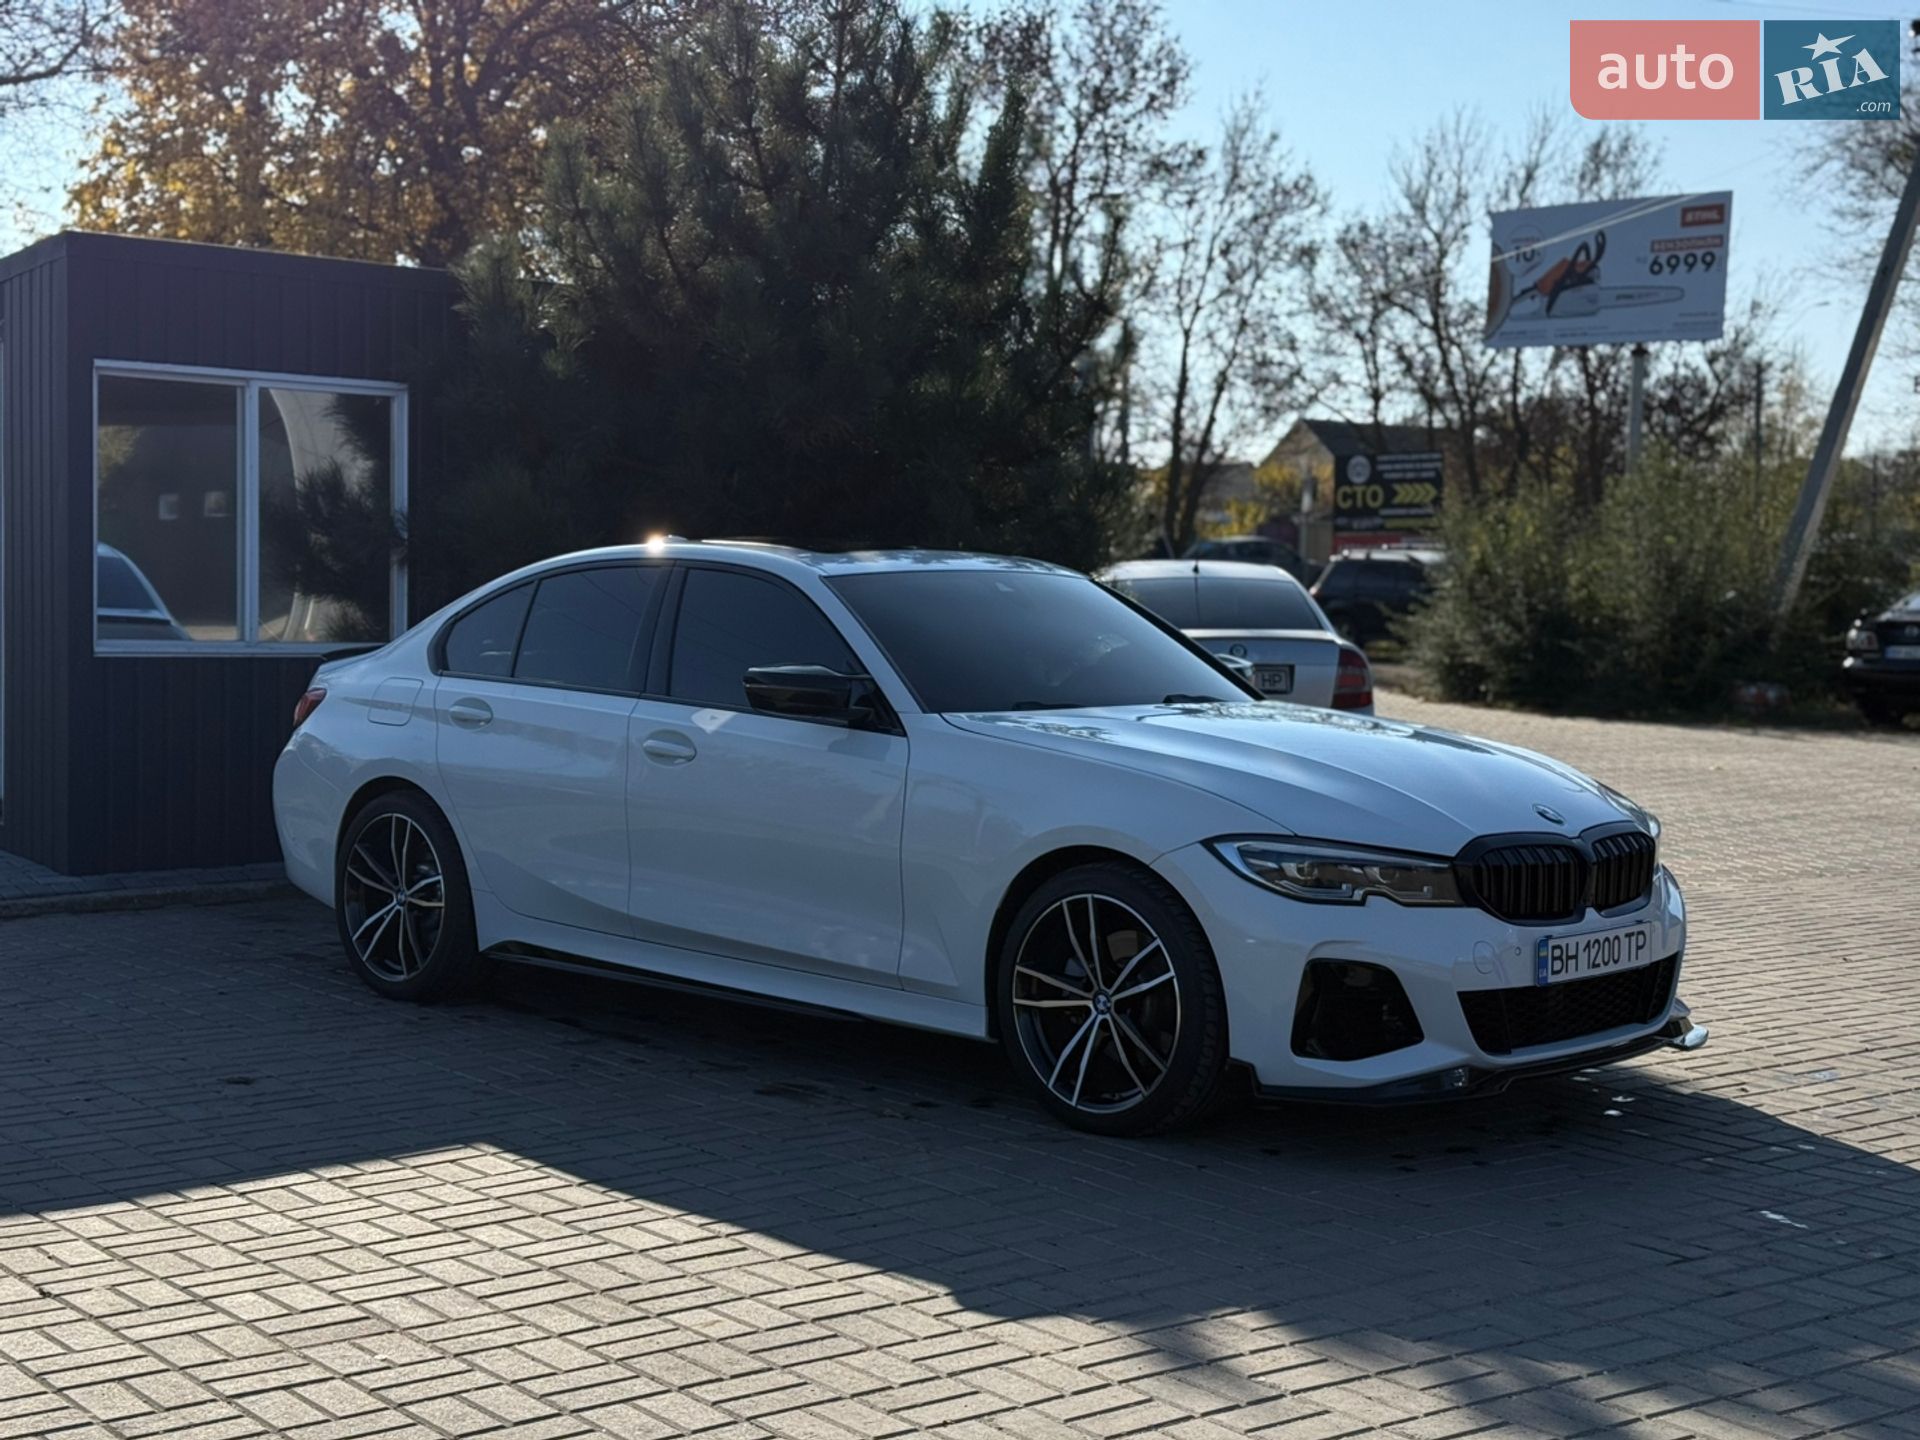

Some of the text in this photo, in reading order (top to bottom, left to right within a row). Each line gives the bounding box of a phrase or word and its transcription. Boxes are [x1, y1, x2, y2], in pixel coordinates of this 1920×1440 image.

[1649, 251, 1716, 276] 6999
[1337, 484, 1384, 509] СТО
[1262, 673, 1282, 688] HP
[1550, 930, 1647, 976] BH 1200 TP
